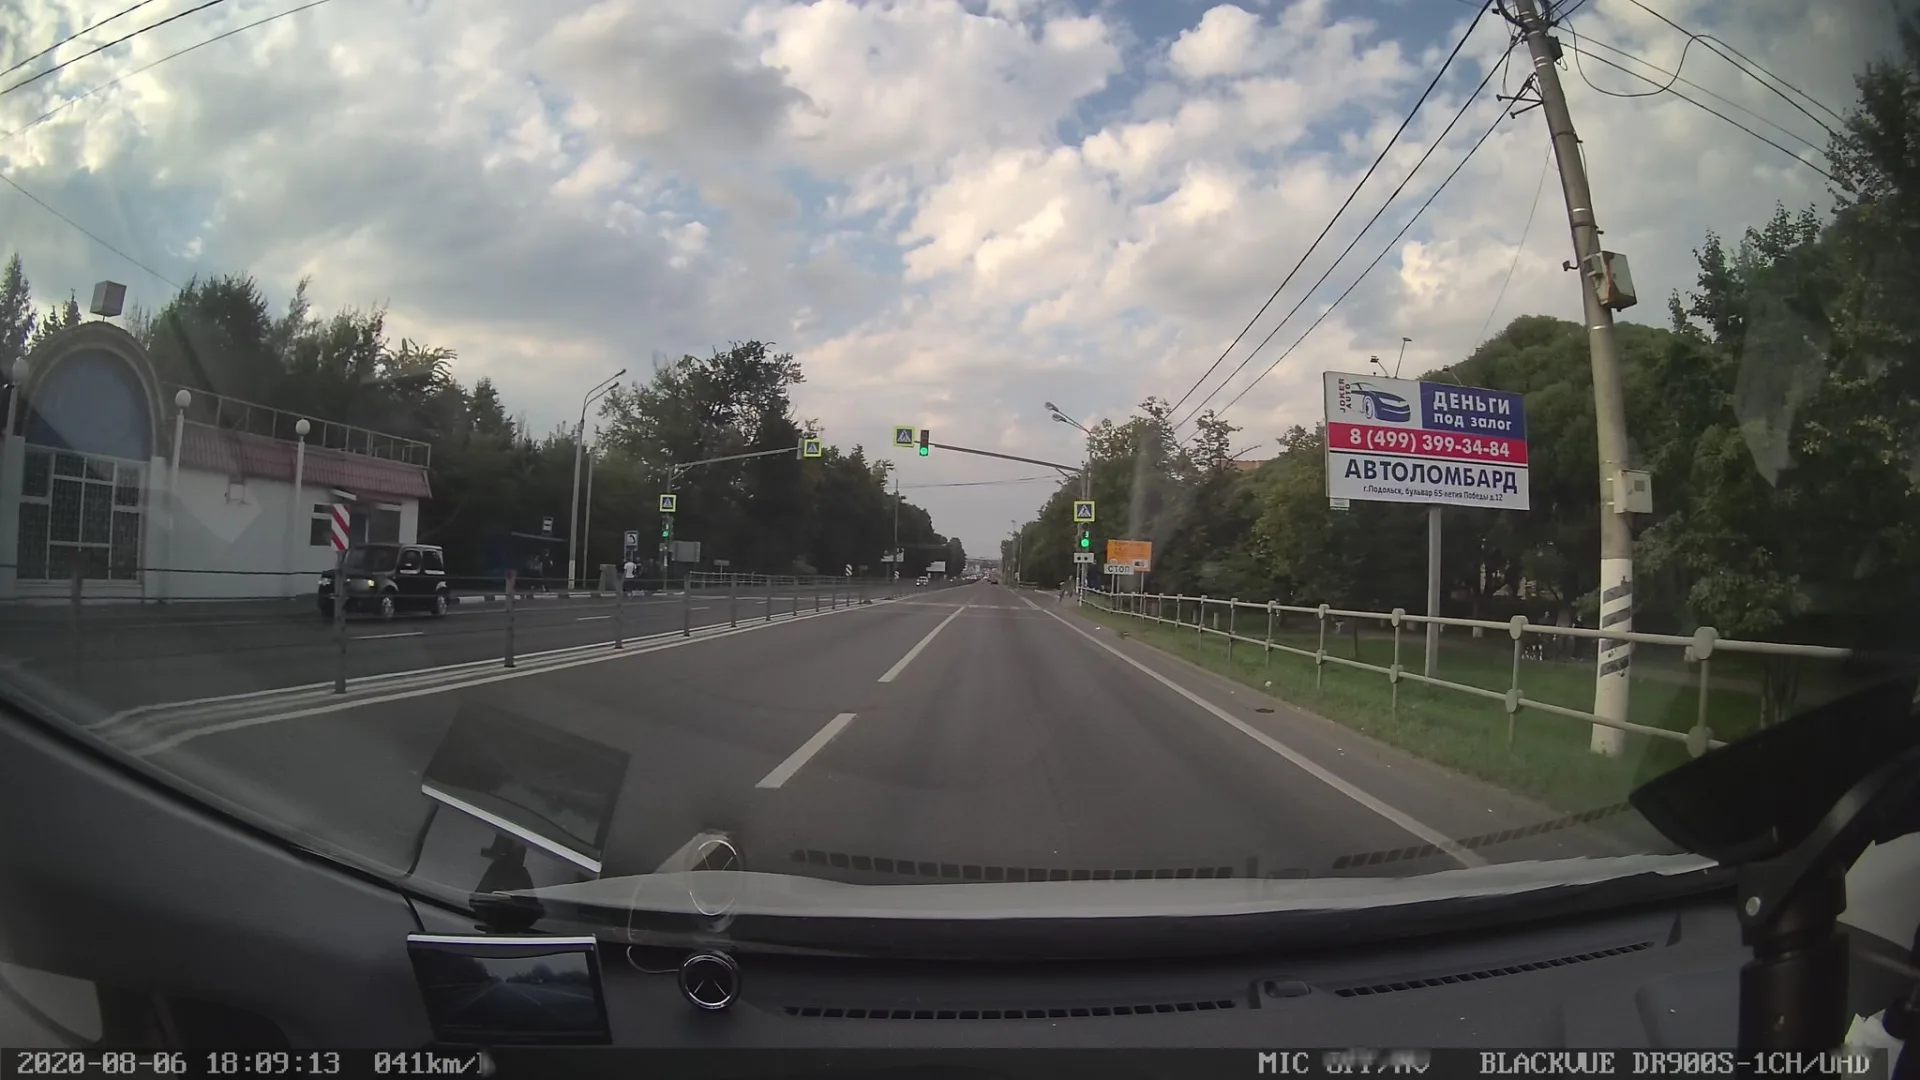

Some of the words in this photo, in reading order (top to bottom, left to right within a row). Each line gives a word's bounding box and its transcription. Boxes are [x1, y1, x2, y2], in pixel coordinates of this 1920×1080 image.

[1338, 378, 1346, 413] JOKER
[1433, 391, 1510, 415] ДЕНЬГИ
[1434, 413, 1464, 428] под
[1470, 416, 1512, 431] залог
[1350, 428, 1361, 444] 8
[1367, 429, 1416, 453] (499)
[1422, 434, 1509, 458] 399-34-84
[1344, 458, 1517, 495] АВТОЛОМБАРД
[1405, 486, 1432, 497] бульвар
[1433, 489, 1462, 498] 65-летия
[1463, 491, 1489, 500] Победы
[1107, 565, 1131, 573] СТОП
